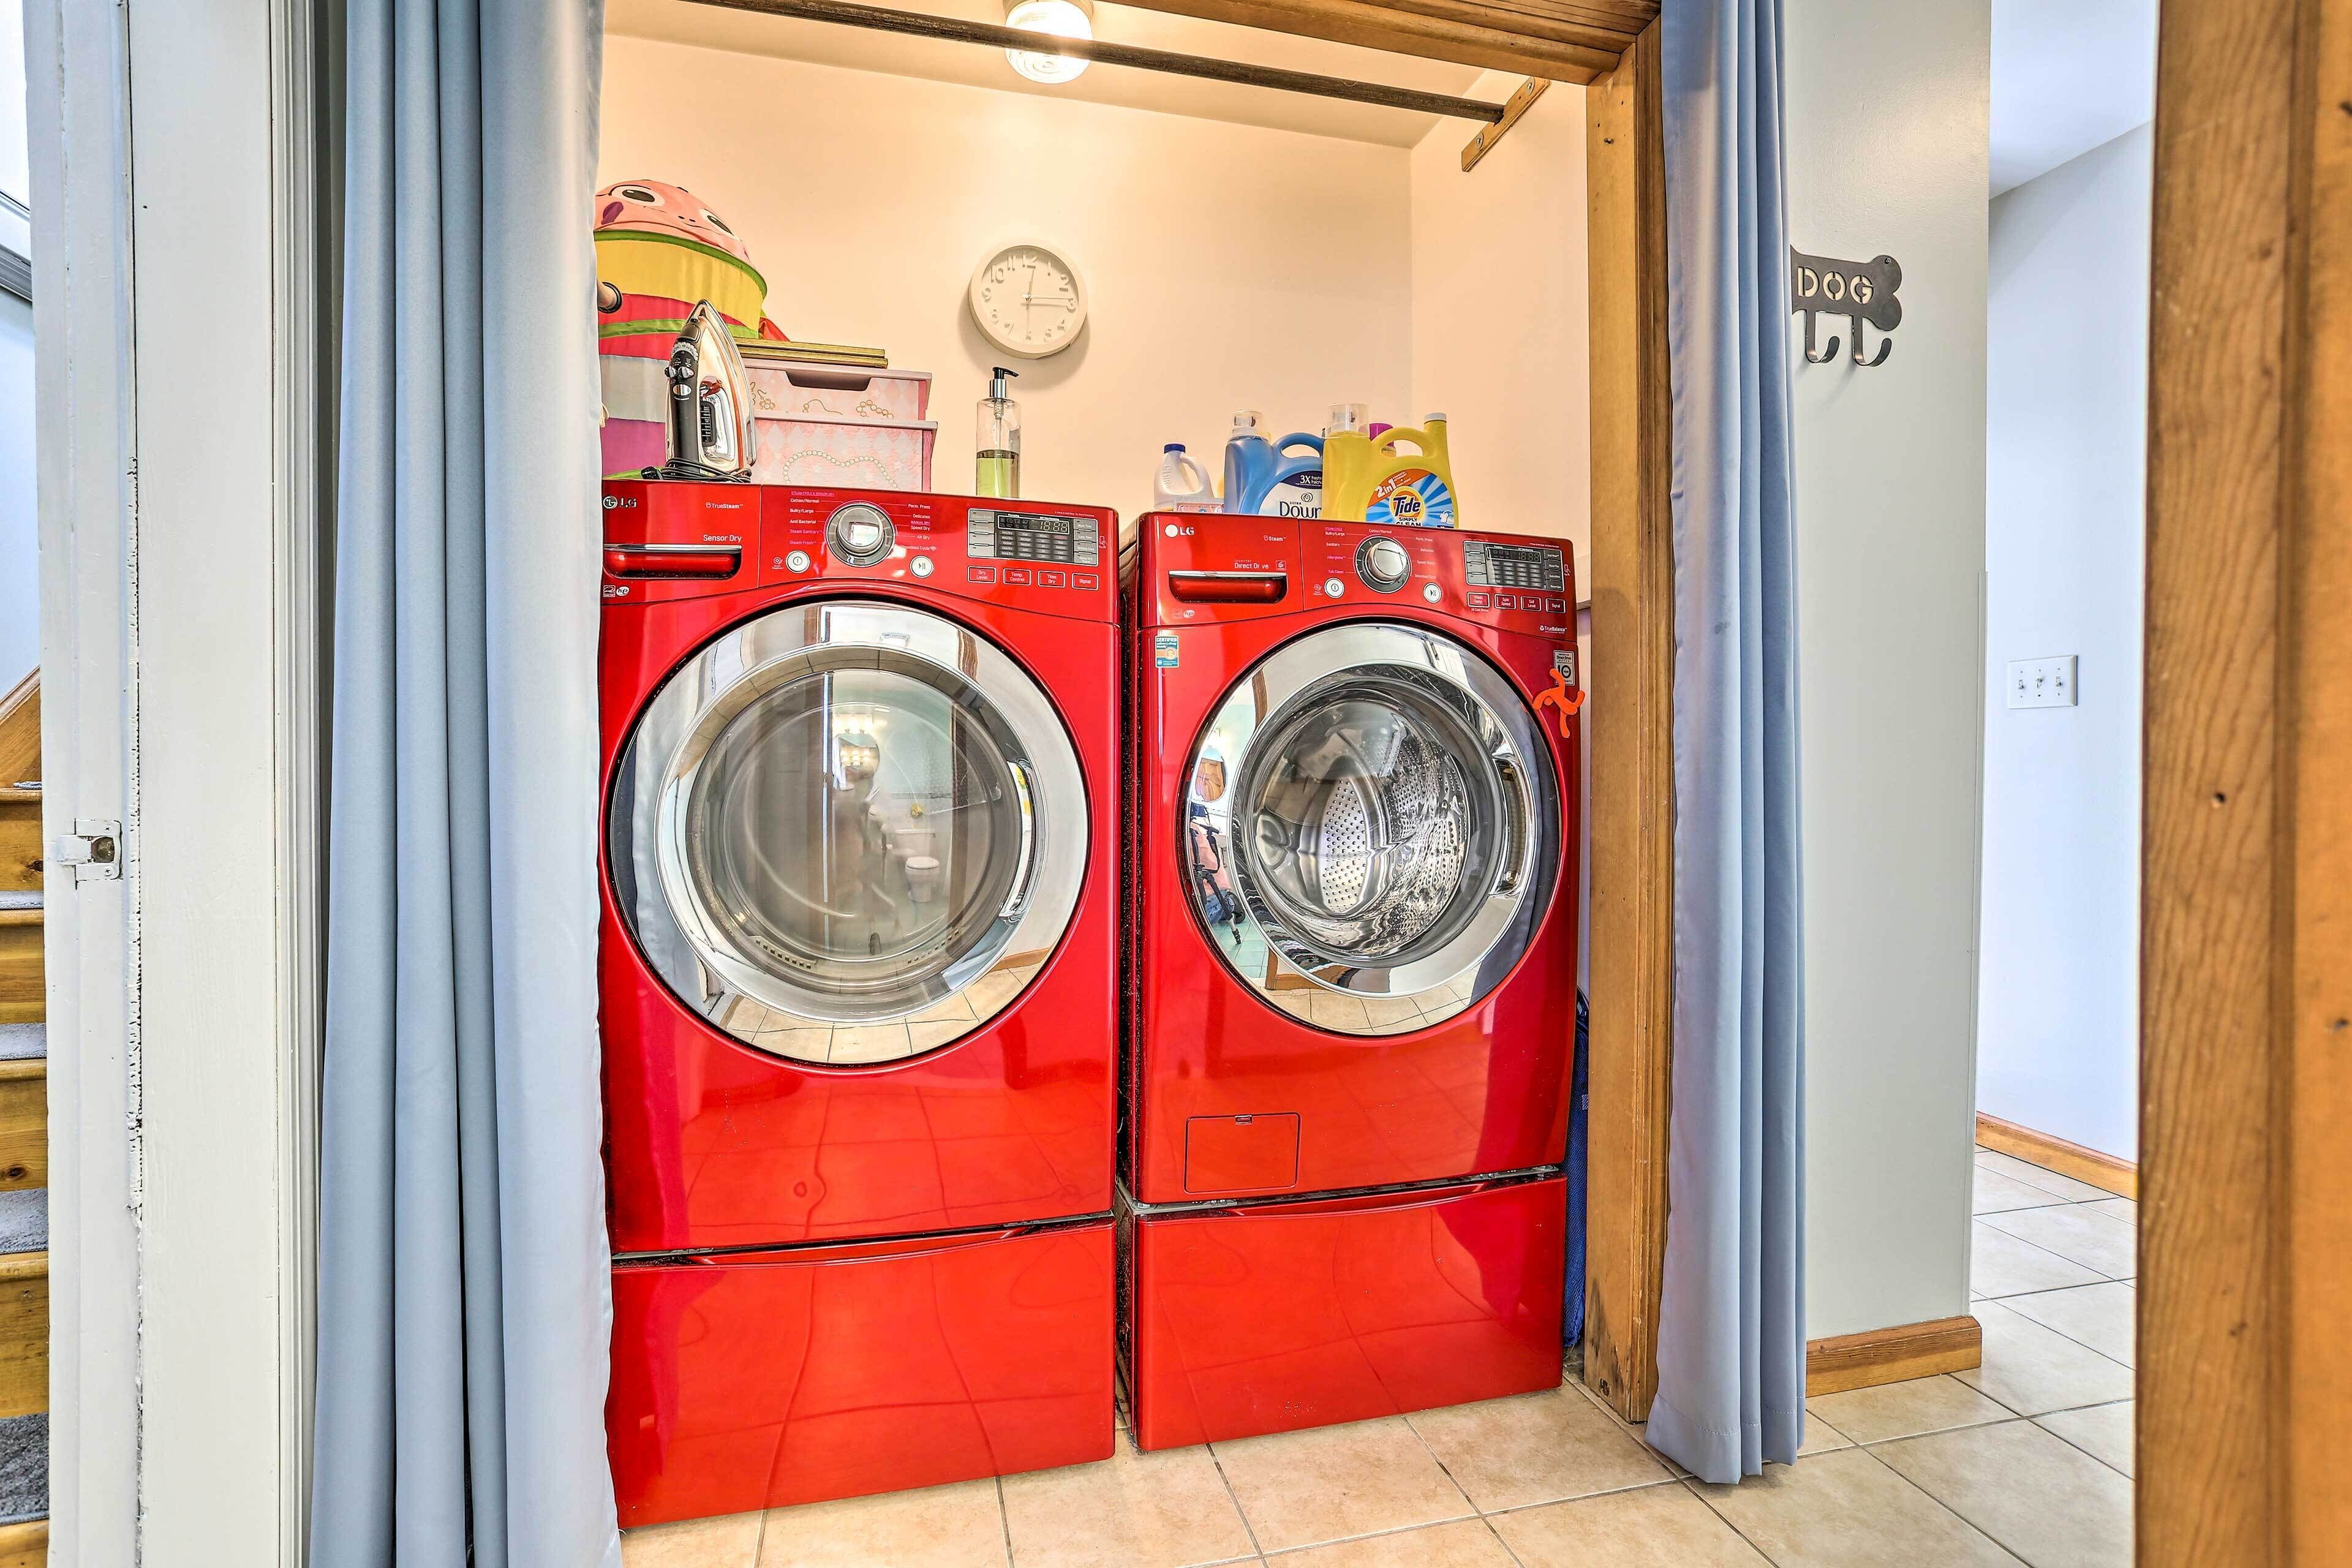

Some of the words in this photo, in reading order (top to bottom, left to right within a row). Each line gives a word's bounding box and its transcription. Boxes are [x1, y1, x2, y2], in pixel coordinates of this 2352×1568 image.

[1007, 254, 1017, 271] 11
[1022, 254, 1038, 270] 12
[990, 265, 1005, 284] 10
[1059, 274, 1070, 293] 2
[1798, 266, 1874, 304] DOG
[981, 287, 992, 303] 9
[1066, 298, 1077, 313] 3
[1300, 475, 1311, 484] 3X
[620, 498, 637, 508] LG
[1393, 495, 1421, 517] Tide
[1180, 527, 1194, 535] LG
